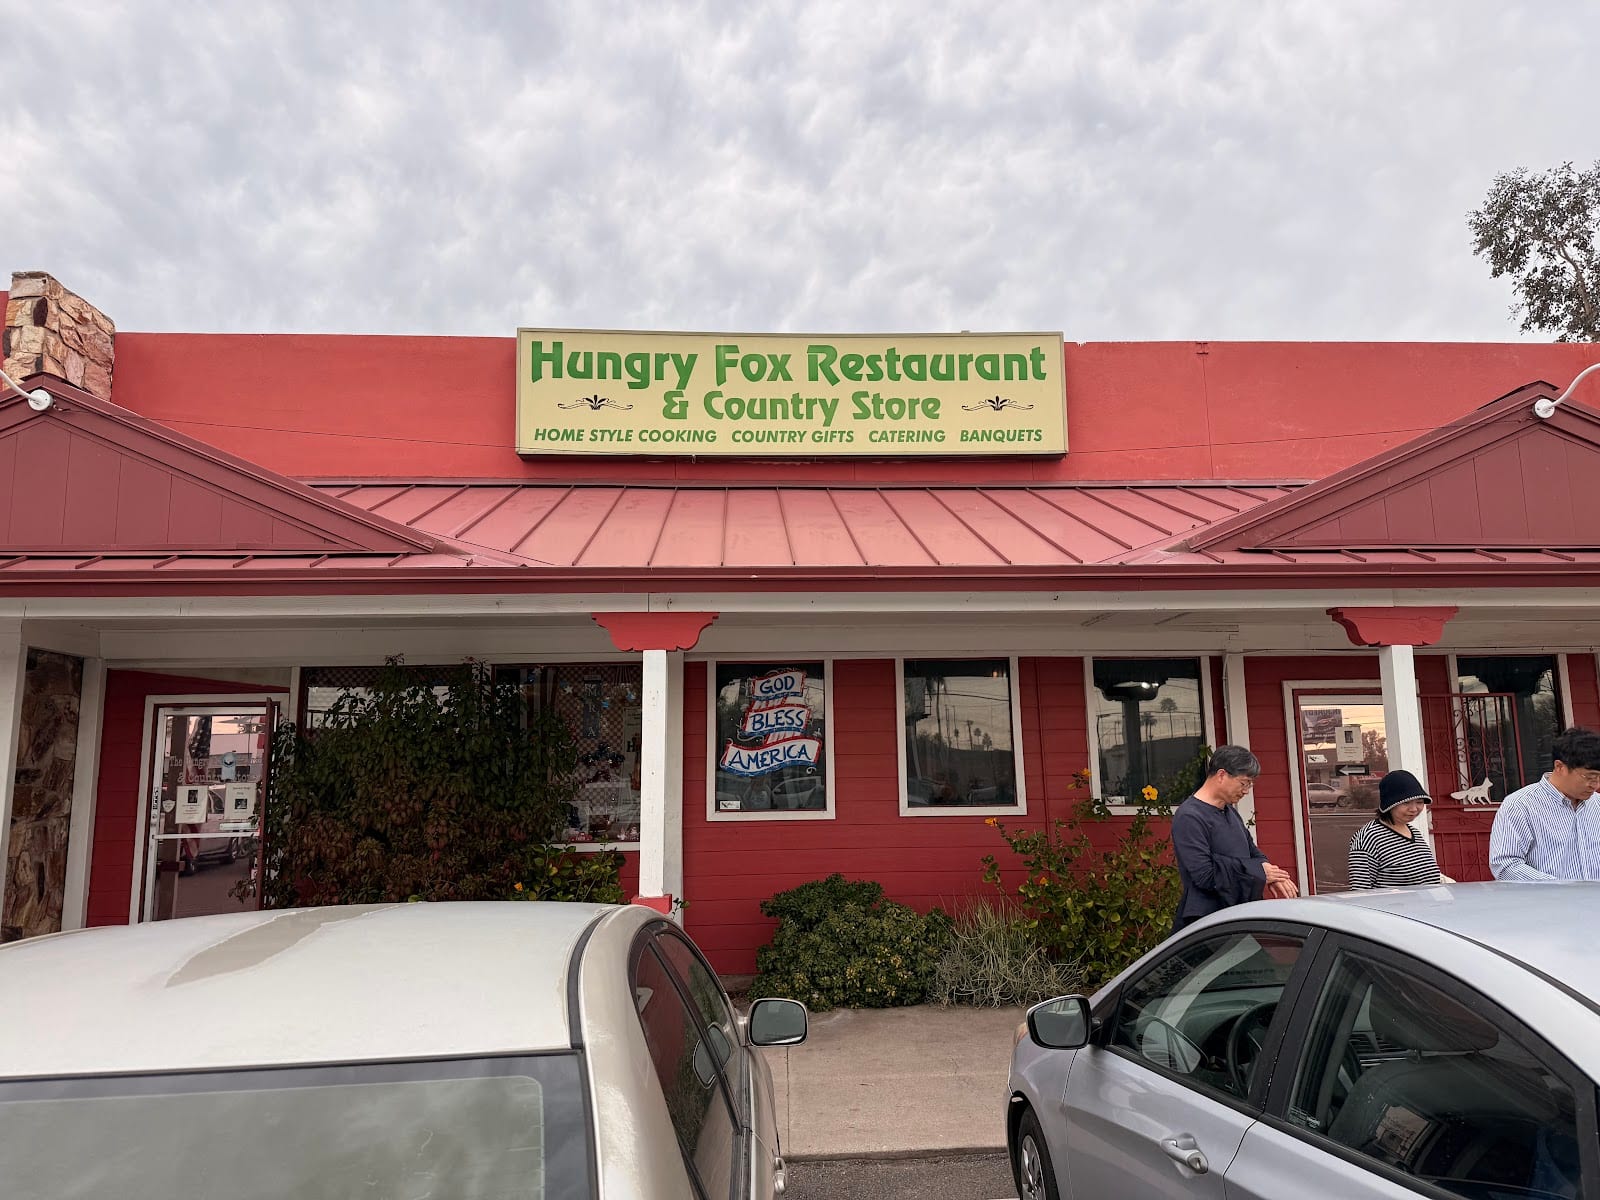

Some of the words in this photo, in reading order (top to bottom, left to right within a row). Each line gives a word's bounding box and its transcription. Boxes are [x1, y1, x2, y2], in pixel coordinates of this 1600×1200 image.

[531, 340, 698, 391] Hungry
[715, 344, 793, 386] Fox
[807, 344, 1047, 386] Restaurant
[662, 390, 689, 421] &
[703, 390, 839, 427] Country
[852, 391, 941, 421] Store
[534, 428, 585, 443] HOME
[588, 428, 633, 443] STYLE
[638, 429, 717, 443] COOKING
[731, 430, 807, 444] COUNTRY
[811, 430, 854, 443] GIFTS
[868, 430, 946, 443] CATERING
[959, 429, 1043, 444] BANQUETS
[759, 675, 795, 694] GOD
[750, 709, 805, 732] BLESS
[728, 744, 812, 769] AMERICA
